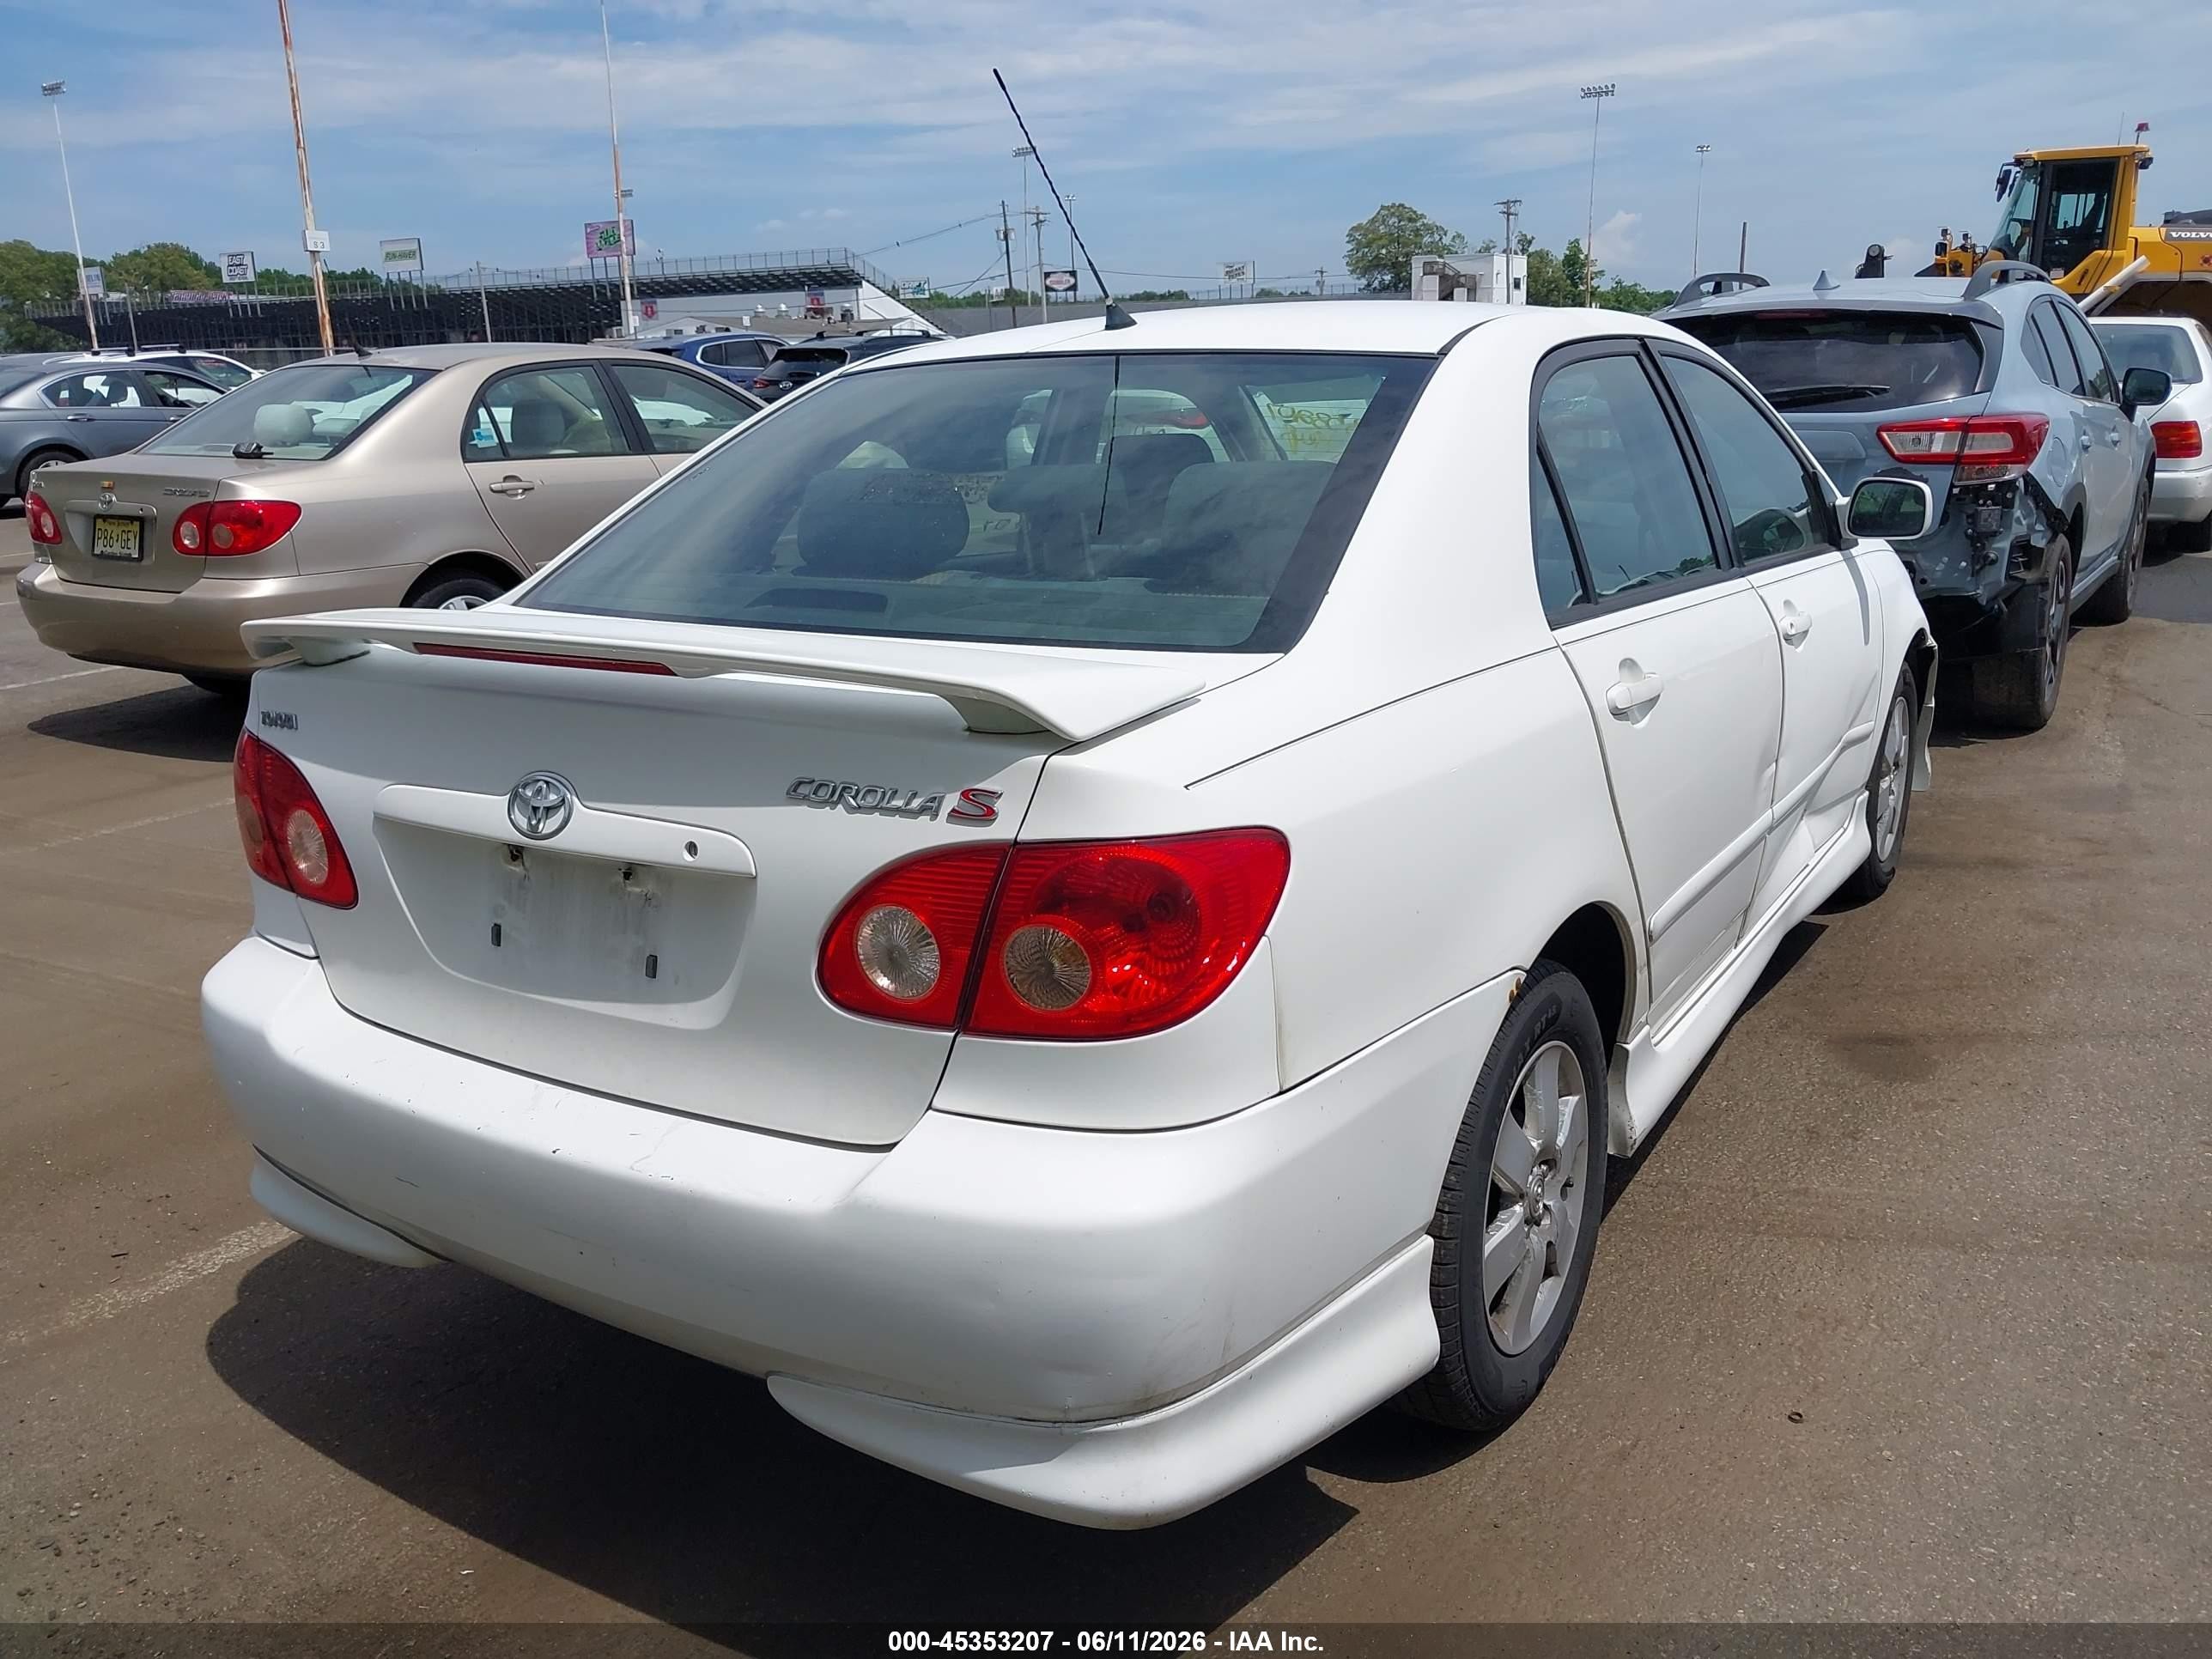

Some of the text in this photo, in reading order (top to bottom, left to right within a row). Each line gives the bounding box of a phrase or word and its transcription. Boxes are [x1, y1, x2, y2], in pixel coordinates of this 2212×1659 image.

[228, 254, 245, 265] EAST
[227, 265, 248, 276] COAST
[786, 776, 1004, 822] COROLLA S
